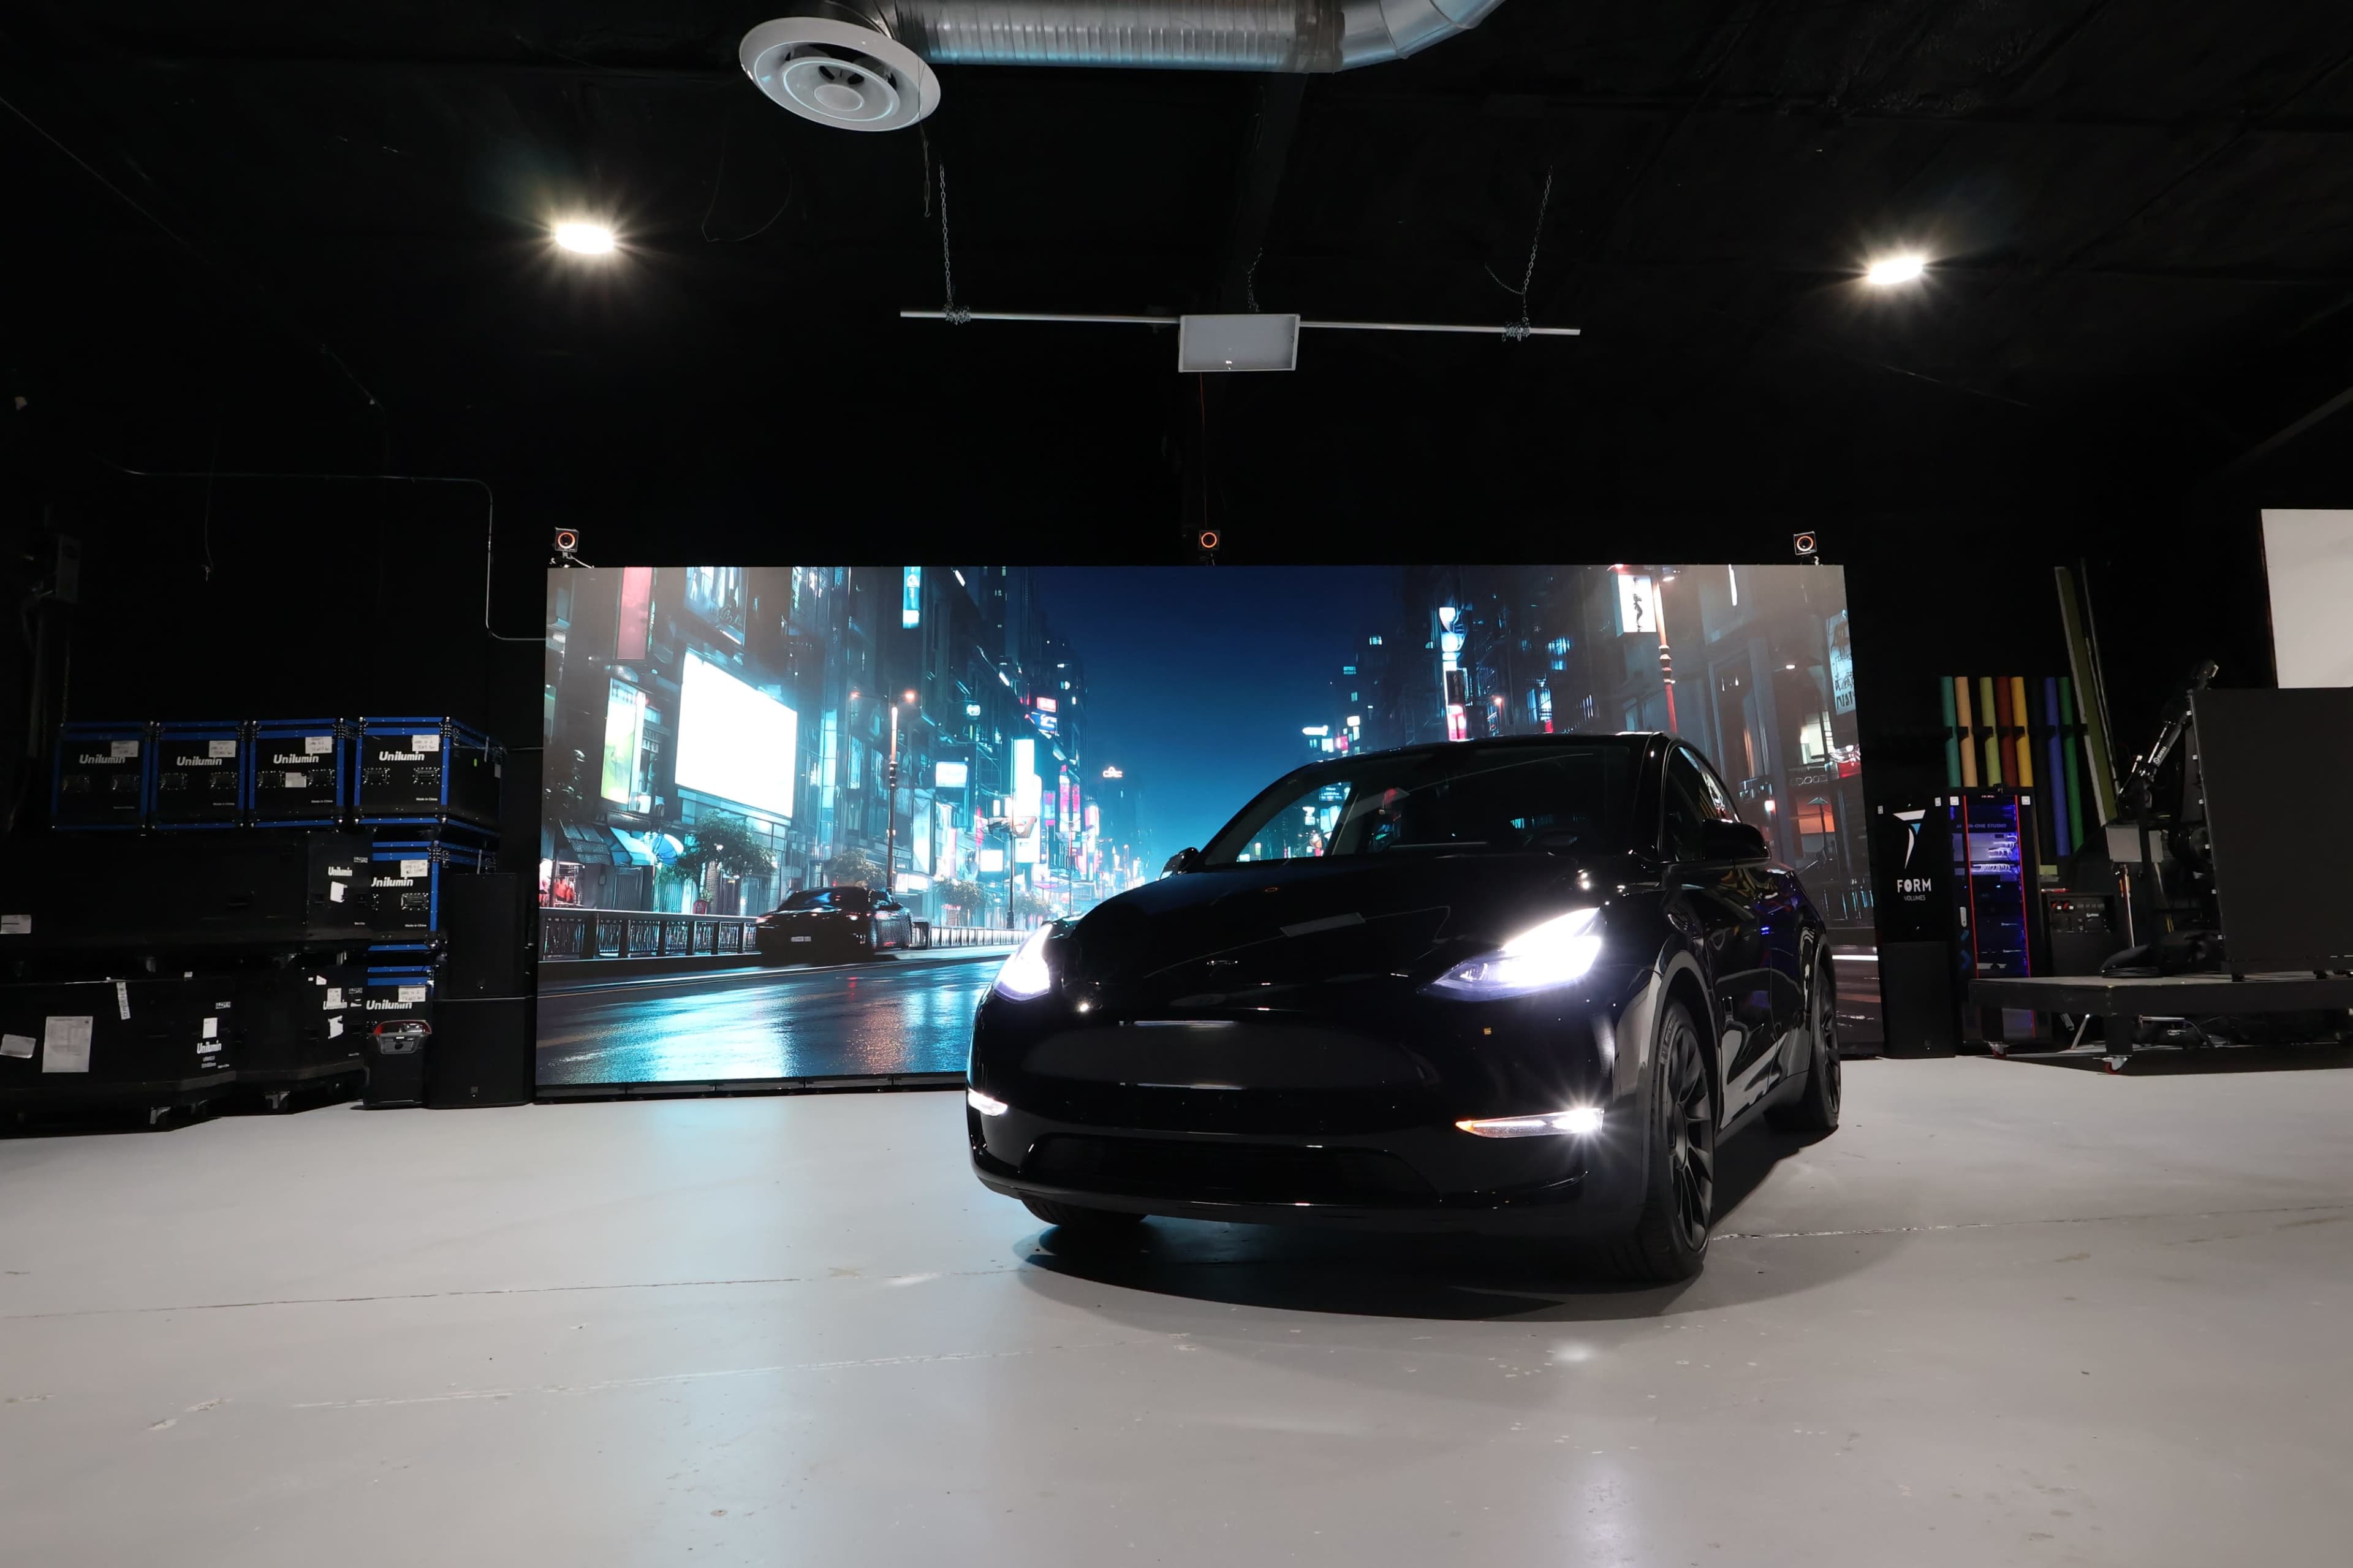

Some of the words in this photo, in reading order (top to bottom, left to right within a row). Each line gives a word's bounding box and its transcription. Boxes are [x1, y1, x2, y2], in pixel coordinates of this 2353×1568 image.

[79, 754, 126, 764] Unilumin
[176, 755, 222, 766] Unilumin
[273, 753, 319, 764] Unilumin
[379, 751, 425, 761] Unilumin
[1896, 877, 1931, 893] FORM
[366, 999, 412, 1010] Unilumin
